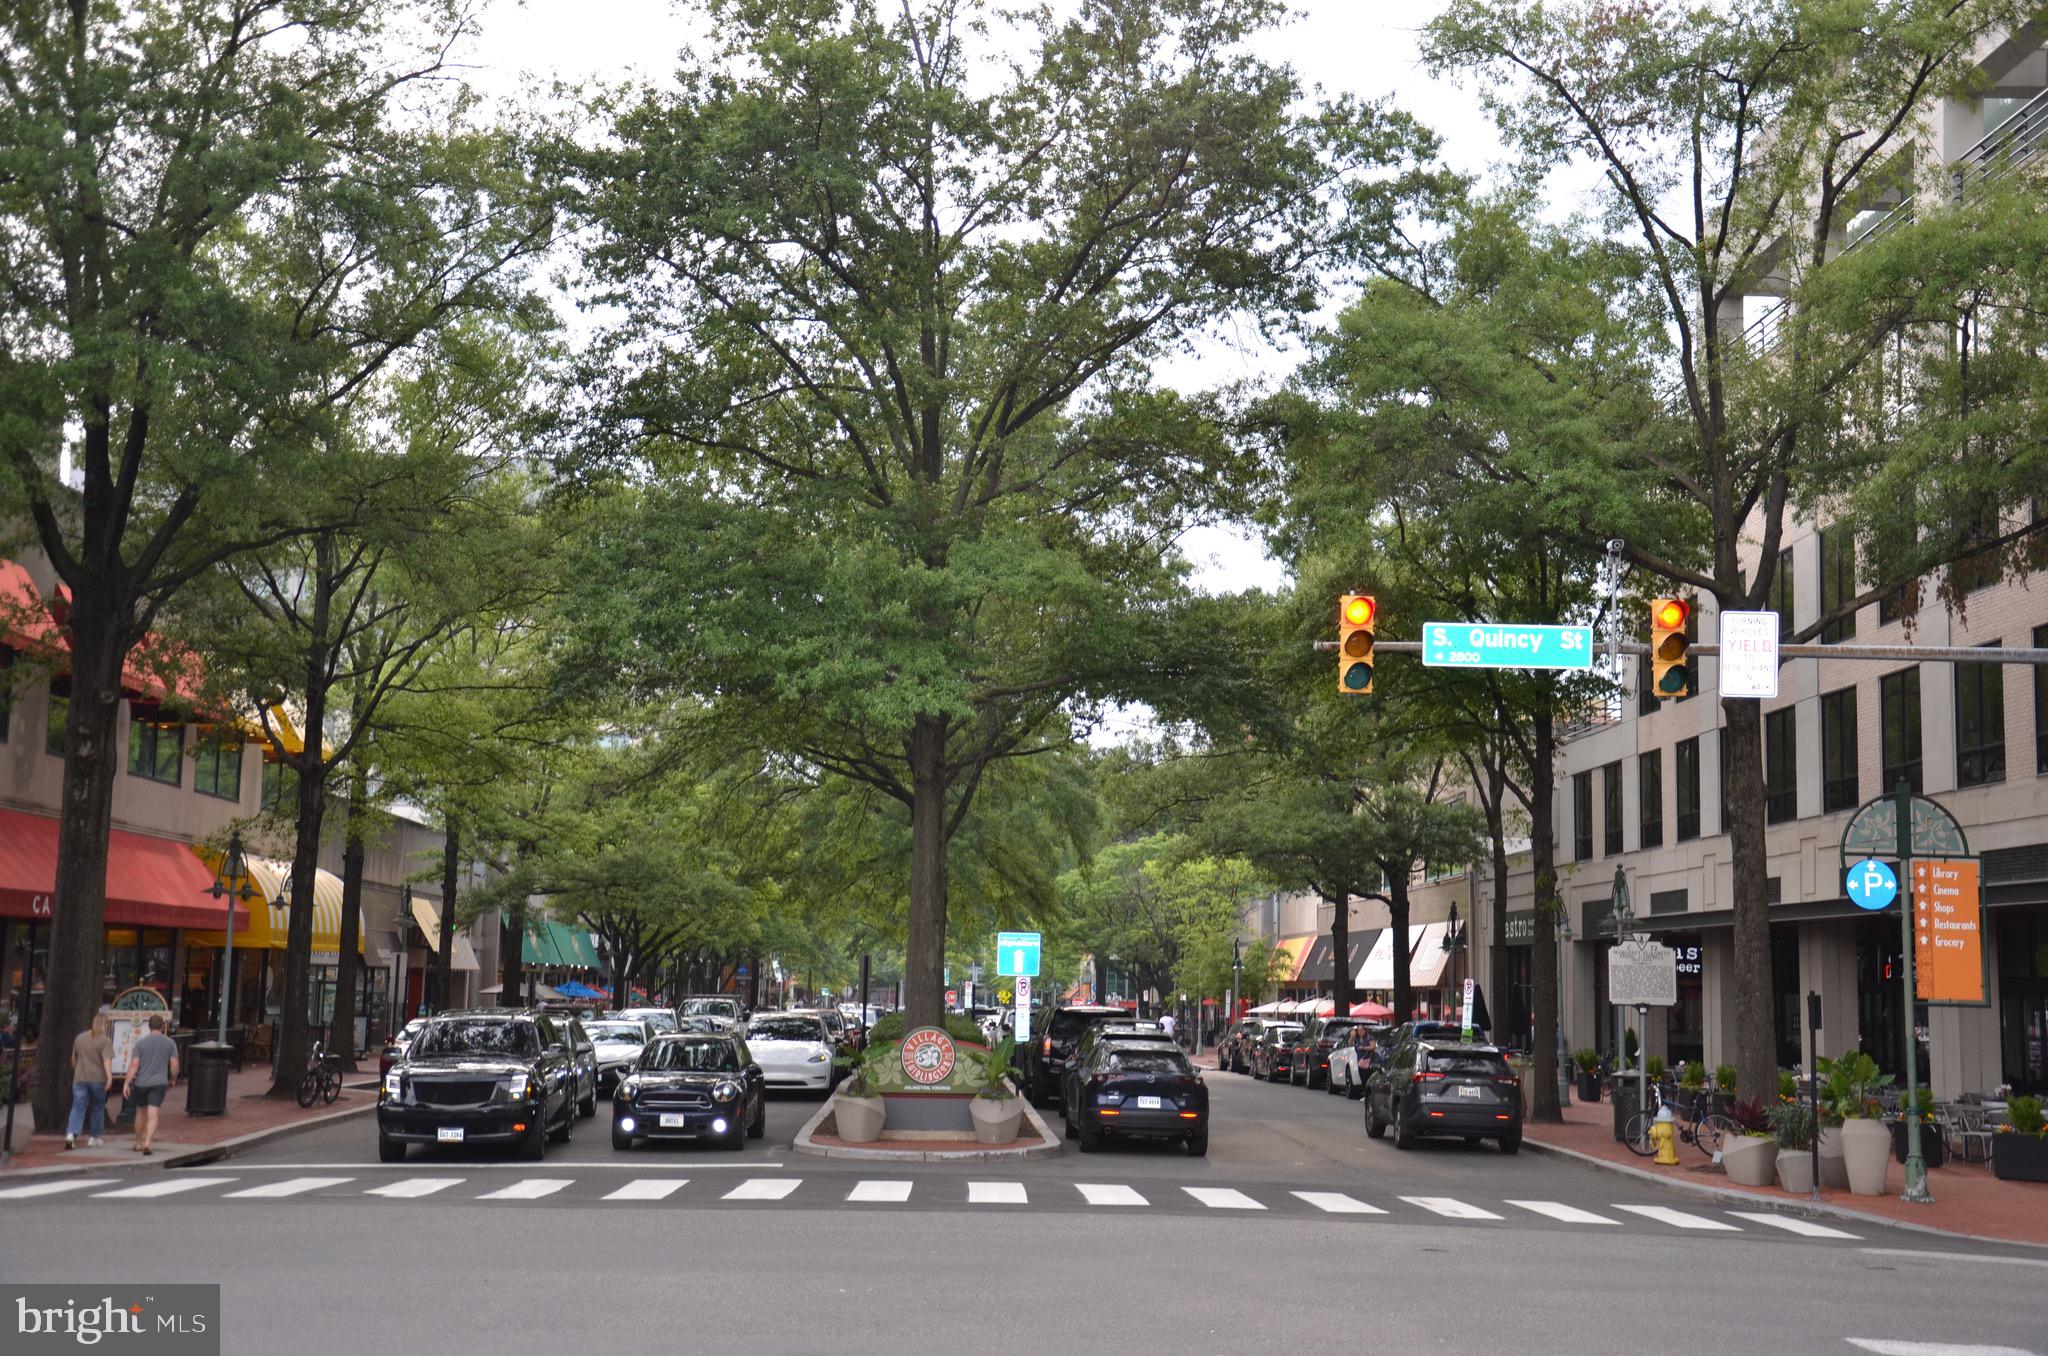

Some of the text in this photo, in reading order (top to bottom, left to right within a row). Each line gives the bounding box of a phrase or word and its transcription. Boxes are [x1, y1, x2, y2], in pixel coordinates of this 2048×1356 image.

[1432, 627, 1583, 653] S. Quincy St
[1728, 639, 1772, 652] YIELD
[1450, 651, 1481, 663] 2800
[1932, 866, 1959, 881] Library
[1864, 872, 1883, 897] P
[1933, 883, 1959, 896] Cinema
[1934, 901, 1954, 915] Shops
[1934, 918, 1977, 930] Restaurants
[1935, 935, 1965, 950] Grocery
[1677, 963, 1701, 973] eer
[905, 1031, 950, 1051] VILLAGE
[904, 1060, 952, 1082] SHIRLINGTON
